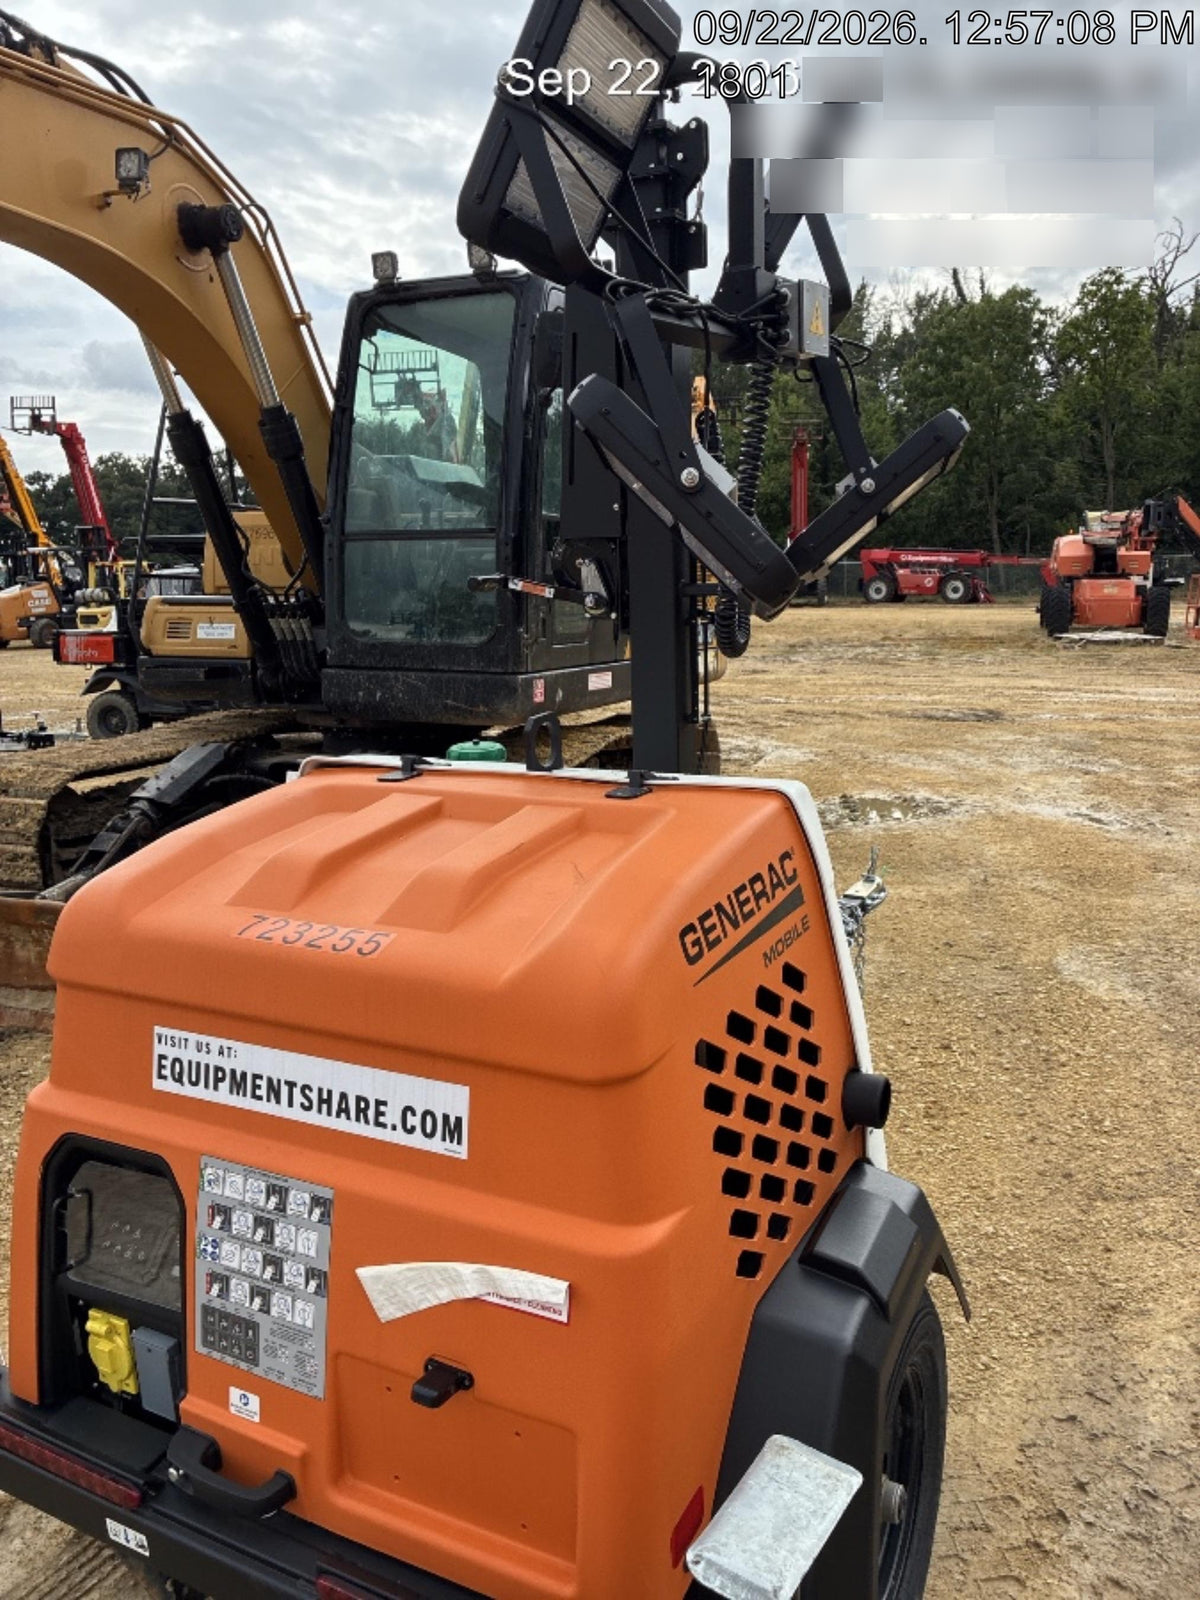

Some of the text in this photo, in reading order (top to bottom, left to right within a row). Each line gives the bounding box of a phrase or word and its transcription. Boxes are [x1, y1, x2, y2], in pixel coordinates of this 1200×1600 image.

[237, 914, 390, 956] 723255
[679, 850, 798, 966] GENERAC
[762, 914, 811, 968] MOBILE
[156, 1032, 237, 1059] VISIT US AT:
[157, 1053, 464, 1147] EQUIPMENTSHARE.COM
